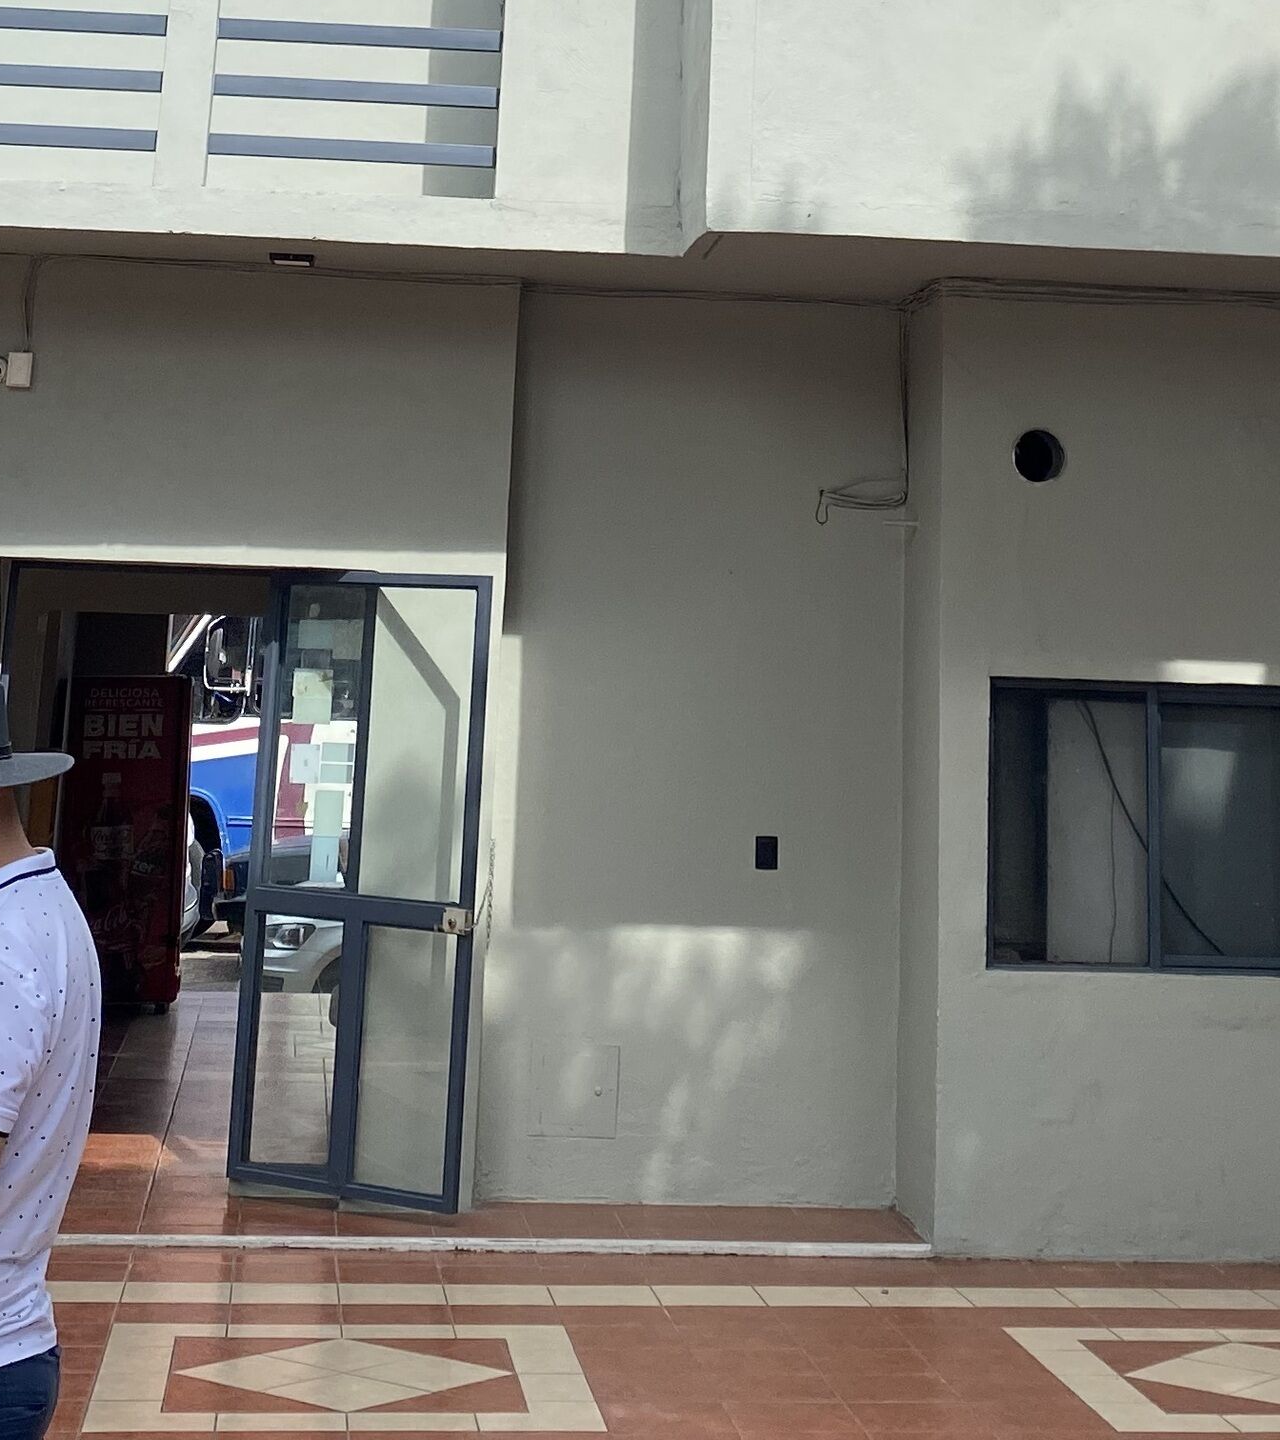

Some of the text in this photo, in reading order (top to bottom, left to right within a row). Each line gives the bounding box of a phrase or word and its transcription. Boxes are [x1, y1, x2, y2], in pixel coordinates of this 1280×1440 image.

[90, 687, 160, 699] DELICIOSA
[83, 713, 164, 736] BIEN
[82, 737, 161, 760] FRÍA
